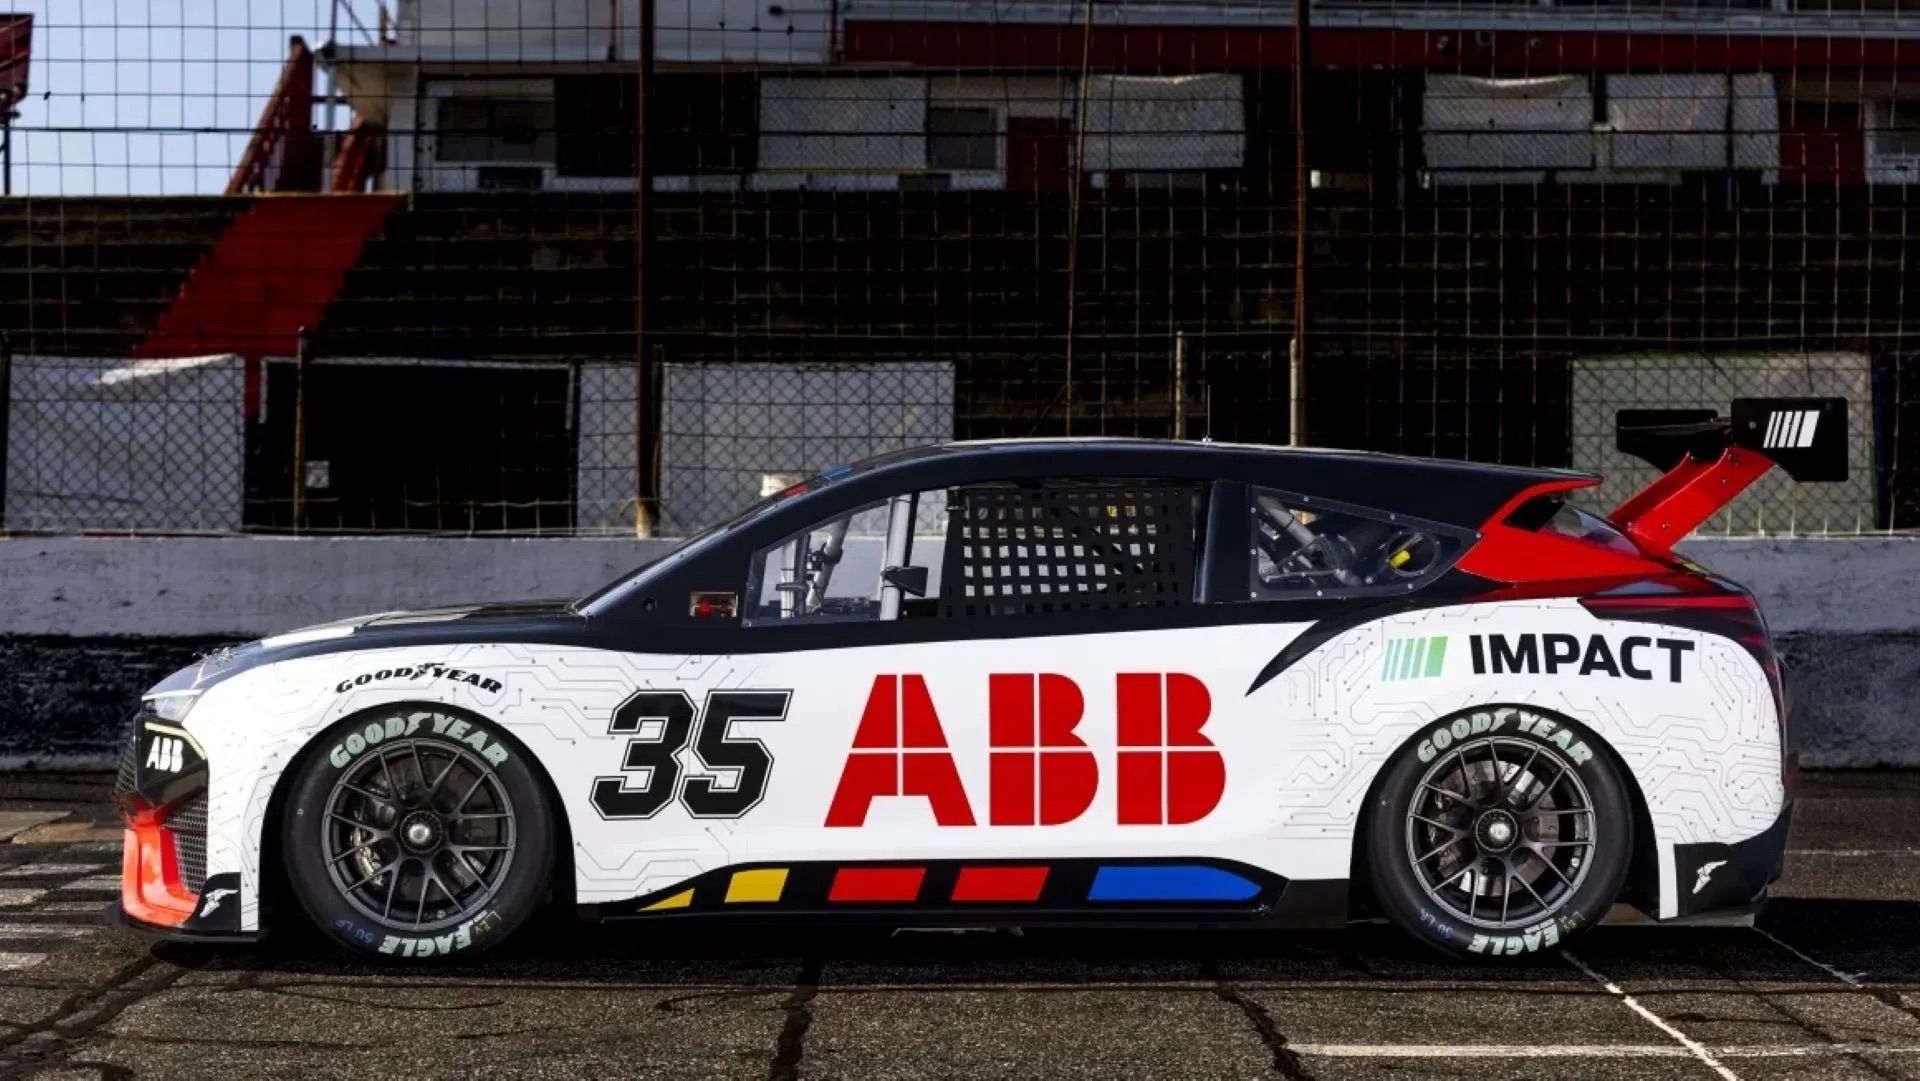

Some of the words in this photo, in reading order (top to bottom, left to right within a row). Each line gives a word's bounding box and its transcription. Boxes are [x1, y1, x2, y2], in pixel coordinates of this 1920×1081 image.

[1469, 633, 1695, 683] IMPACT
[145, 736, 183, 773] ABB
[589, 689, 794, 820] 35
[824, 673, 1226, 827] ABB
[378, 928, 472, 957] EAGLE
[1468, 922, 1560, 956] EAGLE
